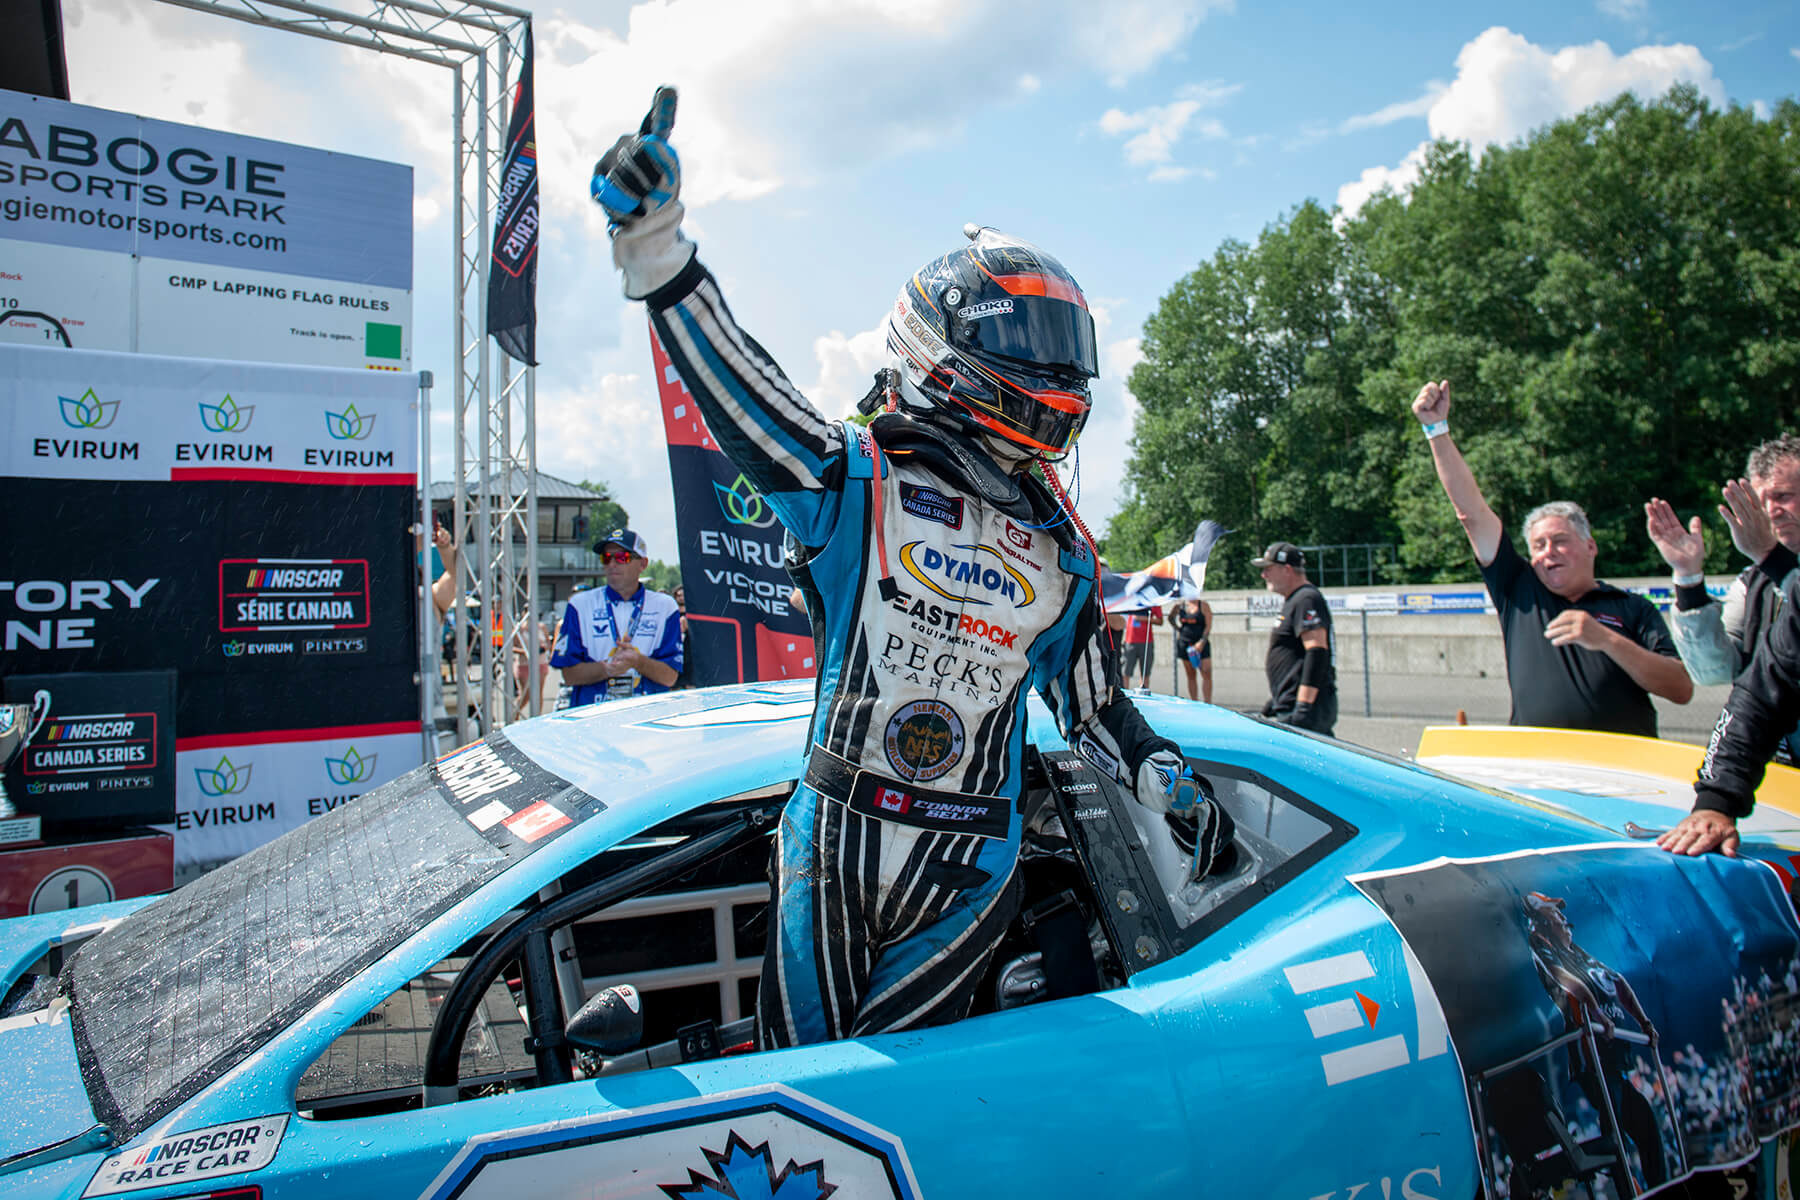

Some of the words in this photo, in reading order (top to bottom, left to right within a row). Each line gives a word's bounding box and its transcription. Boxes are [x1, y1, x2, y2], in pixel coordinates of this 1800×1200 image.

[181, 189, 287, 225] PARK
[0, 195, 287, 253] giemotorsports.com
[168, 275, 208, 290] CMP
[212, 280, 288, 300] LAPPING
[292, 289, 335, 306] FLAG
[339, 295, 391, 312] RULES
[958, 300, 1013, 316] CHOKO
[290, 327, 317, 337] Track
[904, 312, 944, 357] EDGE
[34, 438, 139, 460] EVIRUM
[176, 443, 273, 463] EVIRUM
[304, 448, 394, 467] EVIRUM
[902, 498, 931, 515] CANADA
[932, 508, 956, 524] SERIES
[919, 490, 952, 509] NASCAR
[701, 530, 785, 569] EVIRU
[270, 569, 344, 589] NASCAR
[704, 568, 794, 600] VICTOR
[923, 547, 1015, 603] DYMON
[237, 598, 285, 622] SÉRIE
[287, 601, 354, 621] CANADA
[730, 588, 790, 617] LANE
[0, 617, 95, 651] NE
[910, 621, 976, 649] EQUIPMENT
[980, 645, 998, 657] INC.
[247, 642, 294, 655] EVIRUM
[305, 640, 364, 652] PINTY'S
[881, 632, 1003, 694] PECK'S
[878, 658, 1001, 706] MARINA
[68, 721, 135, 740] NASCAR
[35, 749, 94, 768] CANADA
[97, 746, 146, 764] SERIES
[1057, 760, 1083, 770] EHR
[48, 782, 90, 793] EVIRUM
[100, 777, 151, 789] PINTY'S
[1062, 783, 1098, 793] CHOKO
[175, 802, 275, 831] EVIRUM
[308, 794, 361, 816] EVI
[913, 800, 989, 815] CONNOR
[925, 809, 974, 821] BELL
[64, 878, 79, 909] 1
[156, 1125, 261, 1161] NASCAR
[116, 1160, 190, 1185] RACE
[196, 1150, 251, 1171] CAR
